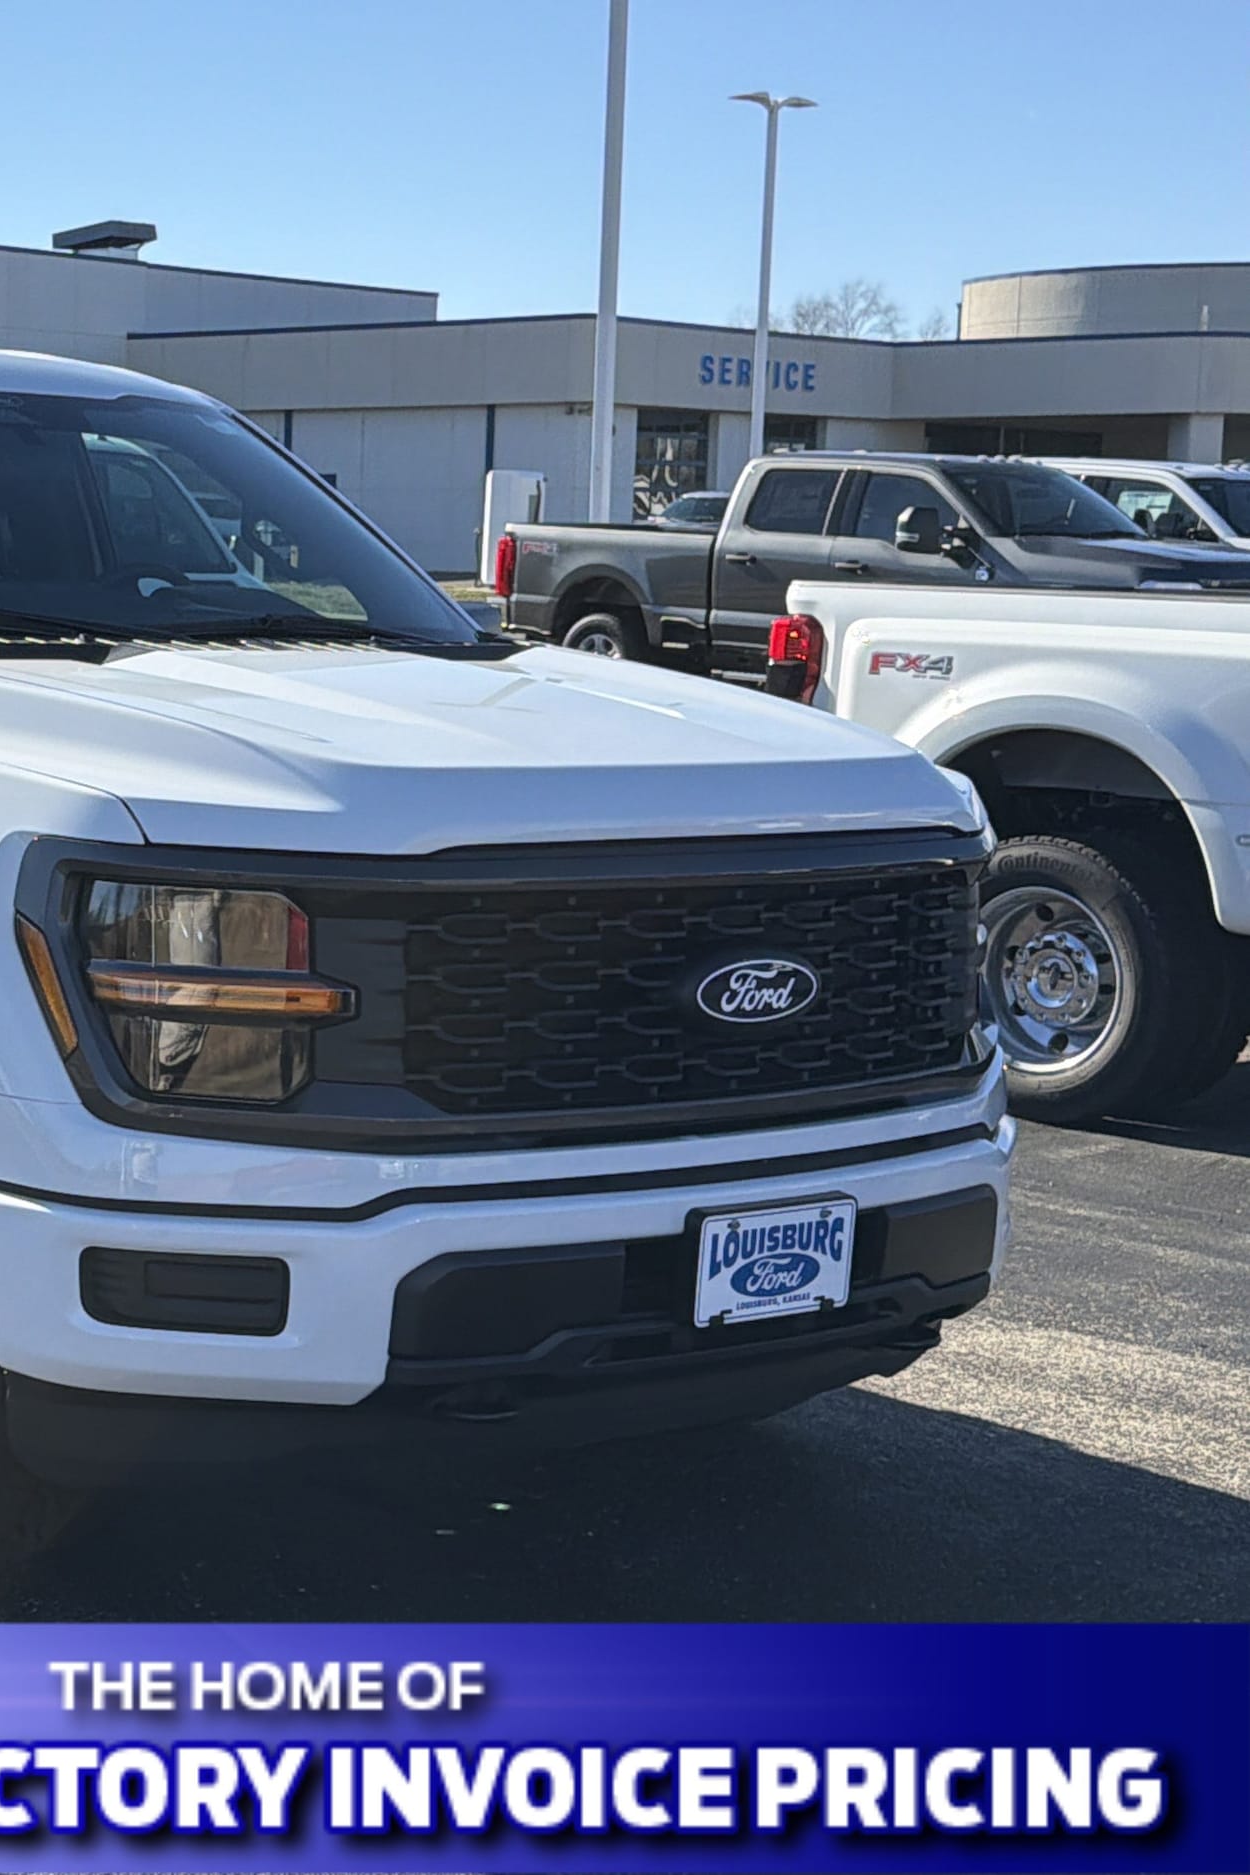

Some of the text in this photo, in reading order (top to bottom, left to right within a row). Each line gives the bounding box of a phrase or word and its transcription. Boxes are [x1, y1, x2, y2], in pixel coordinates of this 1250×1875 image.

[699, 354, 816, 391] SERICE
[868, 652, 954, 675] FX4
[721, 968, 796, 1013] Ford
[708, 1216, 845, 1281] LOUISBURG
[746, 1256, 805, 1293] Ford
